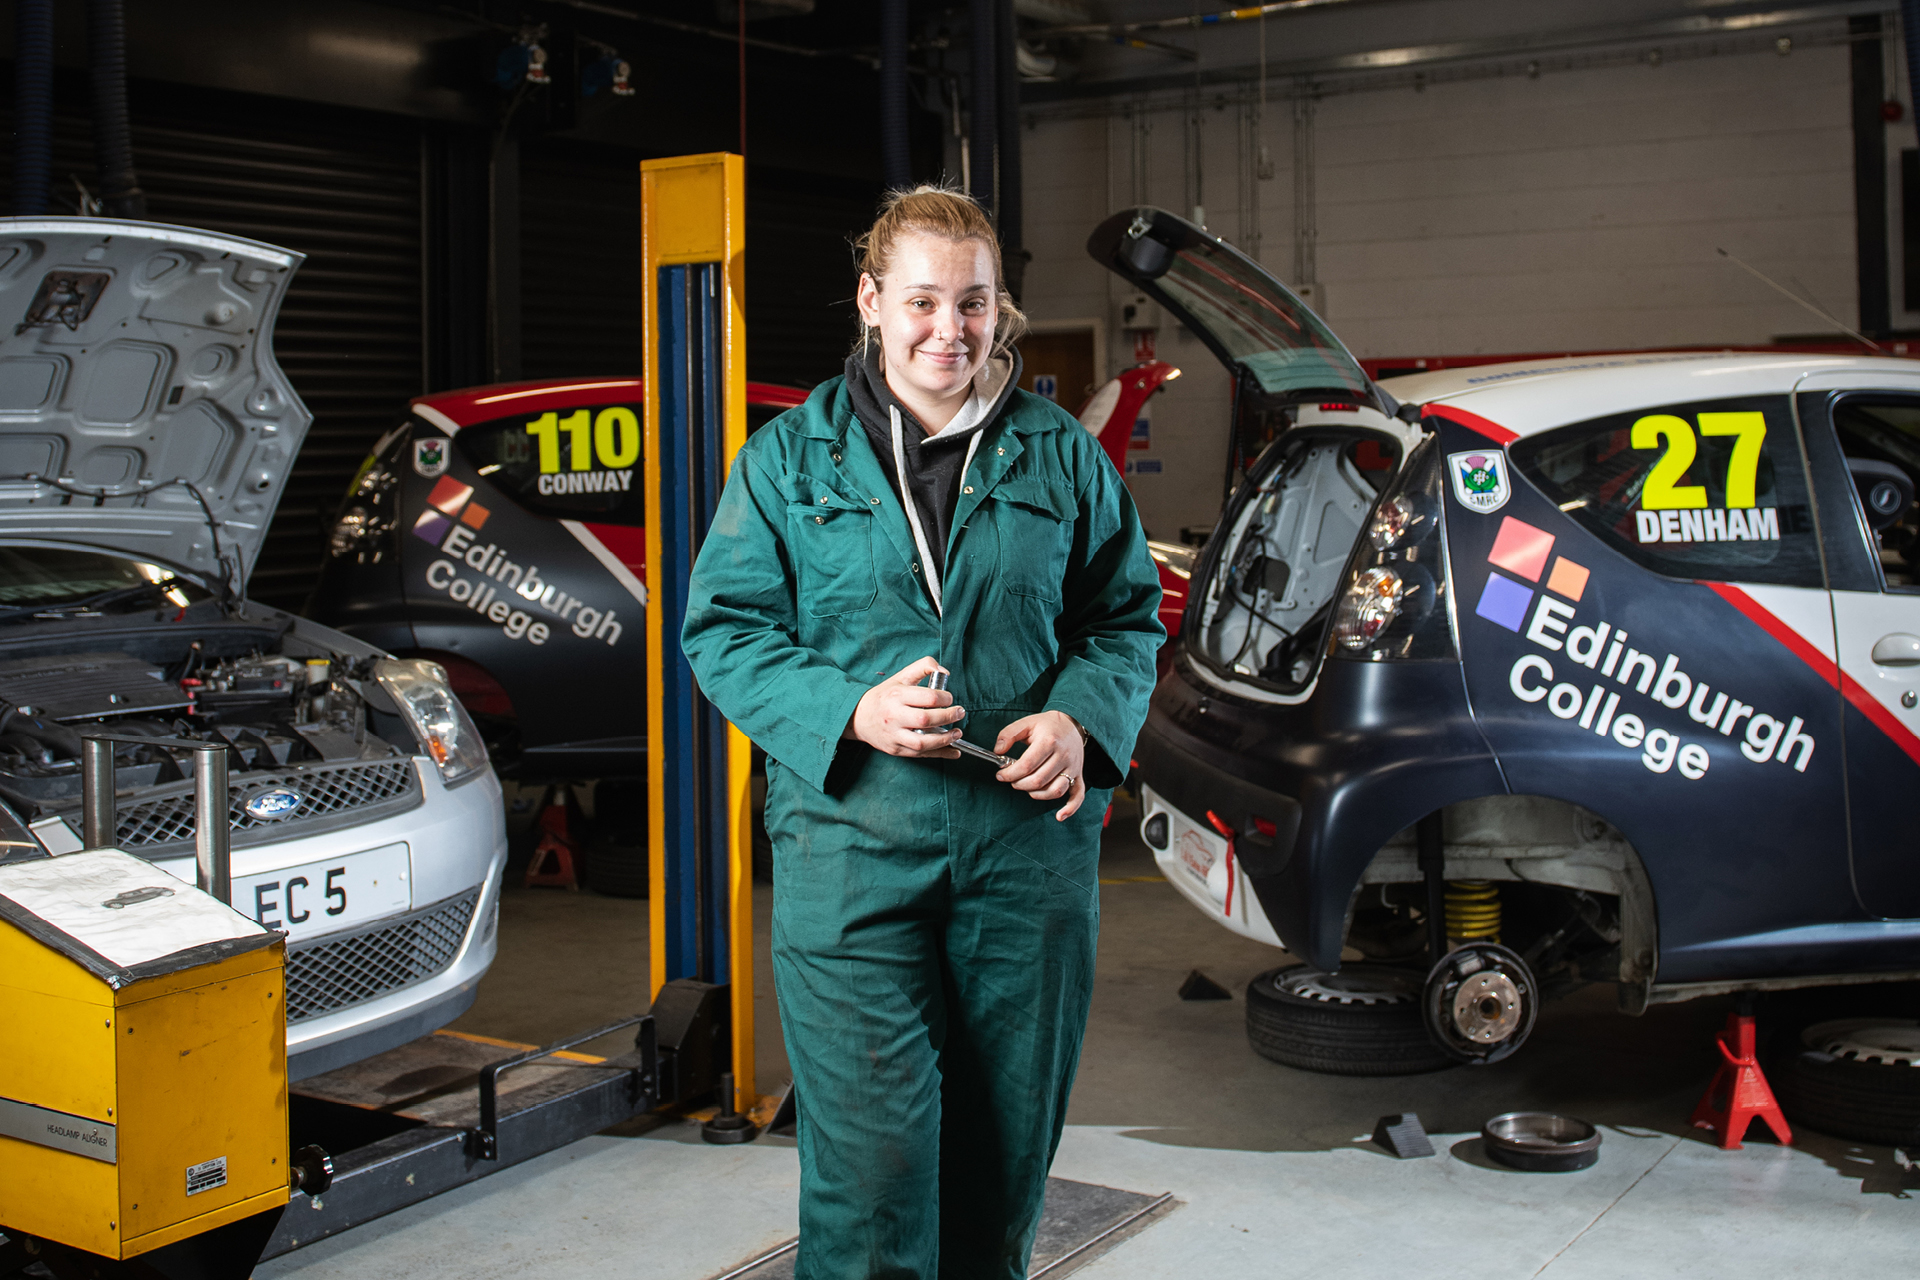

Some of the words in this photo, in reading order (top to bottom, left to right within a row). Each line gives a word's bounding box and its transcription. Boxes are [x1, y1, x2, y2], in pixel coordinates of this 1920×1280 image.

[526, 407, 640, 473] 110
[1631, 411, 1767, 510] 27
[538, 470, 633, 496] CONWAY
[1636, 508, 1780, 543] DENHAM
[425, 559, 550, 646] College
[441, 524, 623, 647] Edinburgh
[1509, 654, 1710, 780] College
[1526, 594, 1816, 773] Edinburgh
[253, 876, 311, 929] EC
[325, 867, 347, 917] 5
[47, 1124, 80, 1140] HEADLAMP
[82, 1133, 108, 1148] ALIGNER
